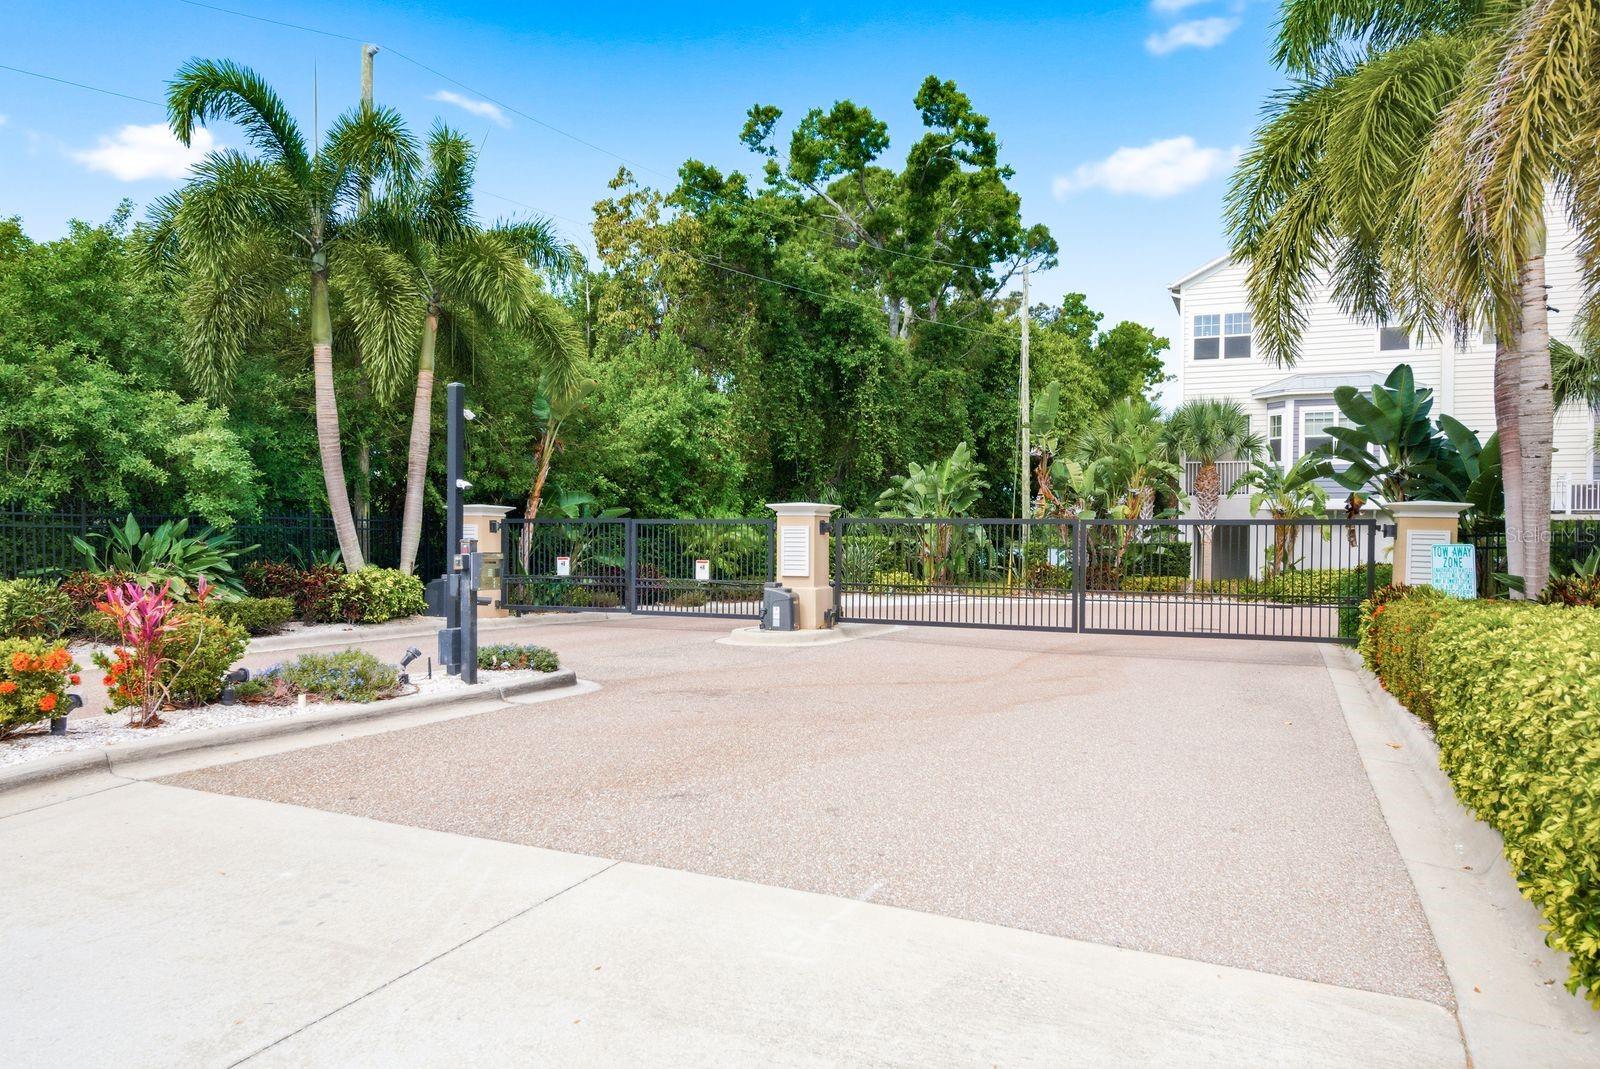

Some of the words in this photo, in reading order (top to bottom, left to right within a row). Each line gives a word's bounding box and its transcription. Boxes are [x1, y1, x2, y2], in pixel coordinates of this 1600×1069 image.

[1433, 546, 1449, 557] TOW
[1451, 547, 1472, 557] AWAY
[1443, 557, 1463, 568] ZONE
